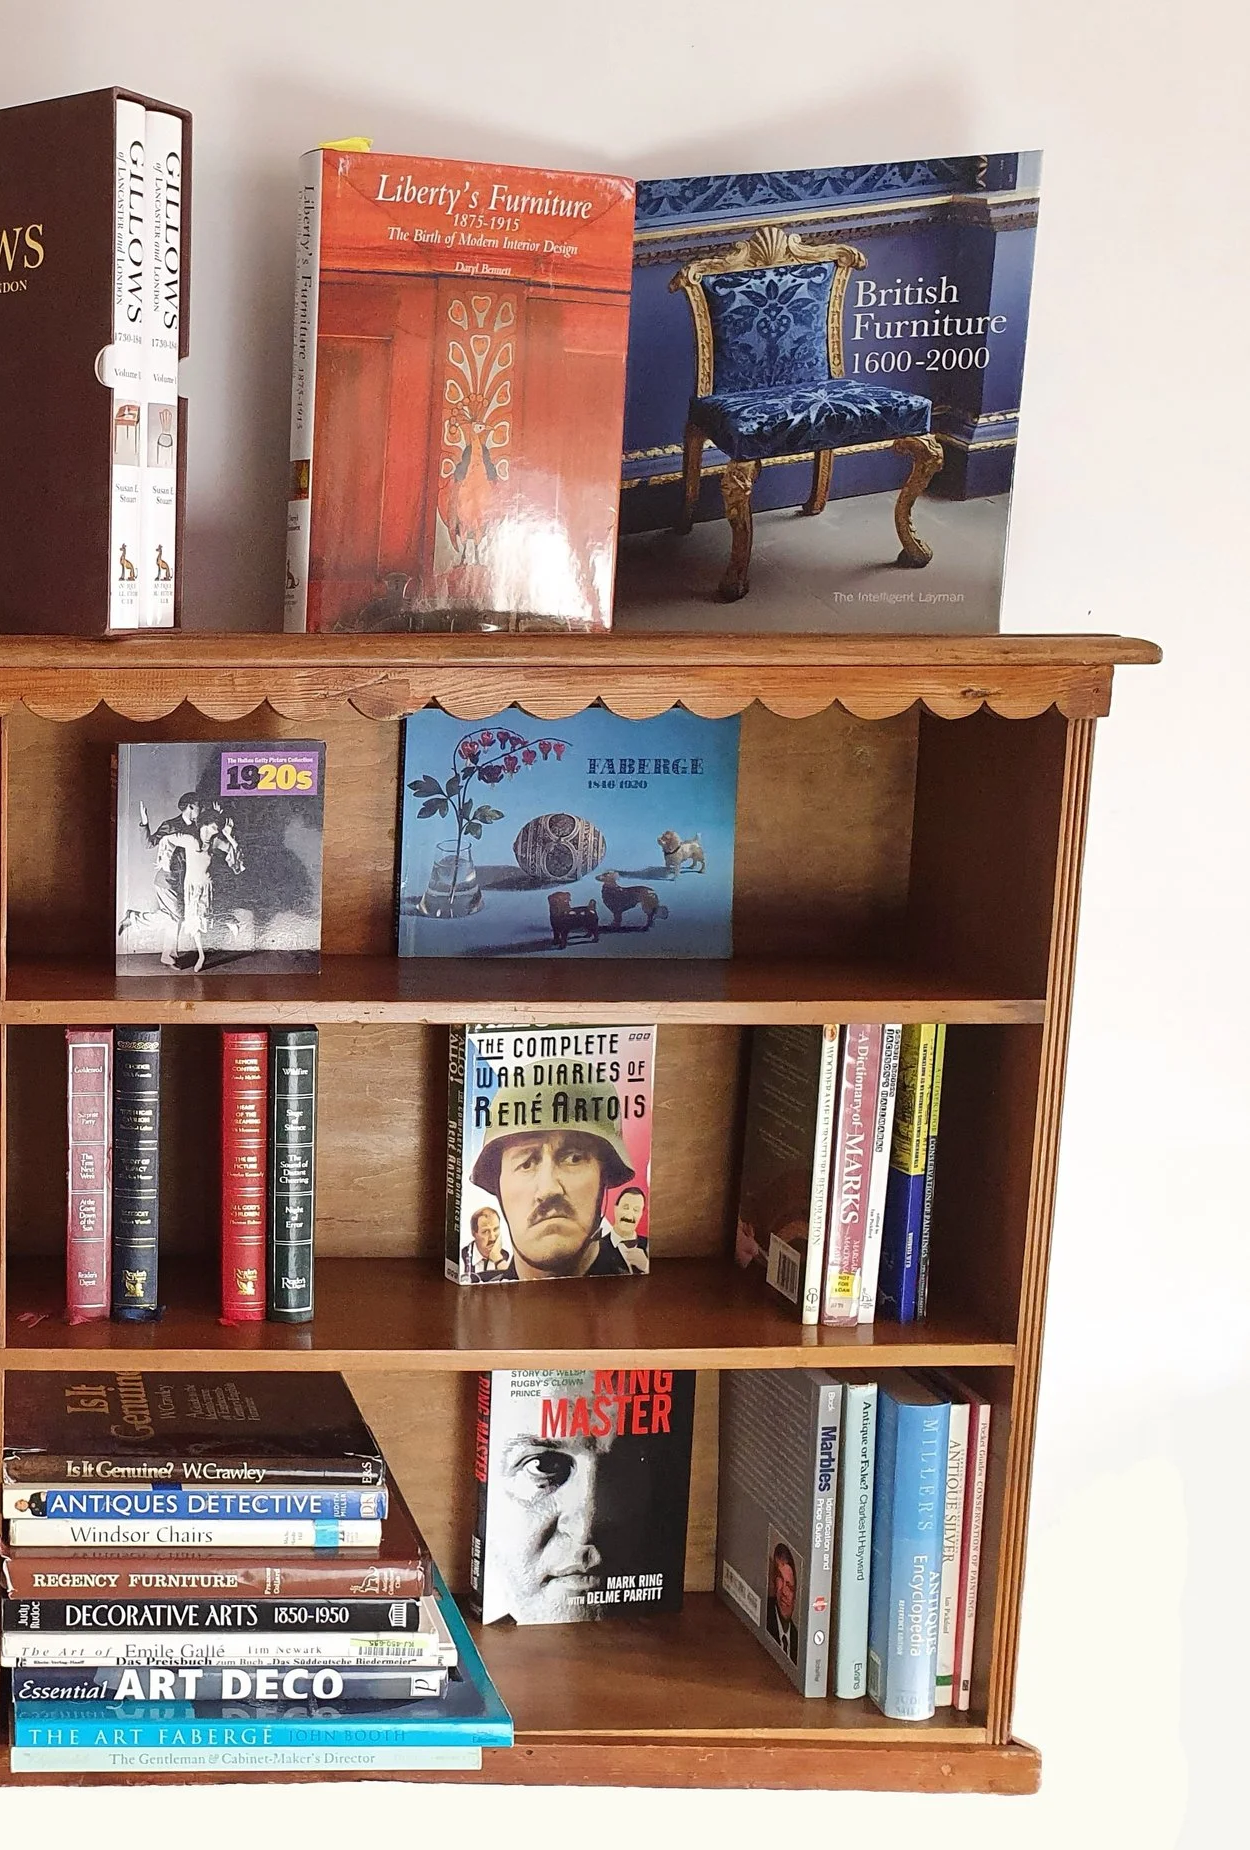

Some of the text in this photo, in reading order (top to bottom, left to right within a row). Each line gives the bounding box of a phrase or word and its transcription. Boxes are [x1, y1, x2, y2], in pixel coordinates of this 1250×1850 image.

[375, 173, 593, 220] Liberty's Furniture
[126, 140, 145, 323] GILLOWS
[452, 213, 520, 232] 1875-1915
[163, 151, 181, 330] GILLOWS
[387, 226, 578, 258] The Birth of Modern Interior Design
[454, 261, 512, 276] Daryl Bennett
[853, 275, 960, 309] British
[850, 308, 1008, 342] Furniture
[851, 346, 990, 374] 1600-2000
[833, 591, 965, 604] The Intelligent Layman
[226, 763, 313, 791] 1920s
[586, 757, 705, 775] FABERGE
[476, 1033, 620, 1059] THE COMPLETE
[475, 1060, 646, 1090] WAR DIARIES OF
[840, 1032, 869, 1225] A Dictionary of MARKS
[285, 1220, 304, 1229] Error
[510, 1370, 540, 1378] STORY
[542, 1369, 554, 1377] OF
[510, 1378, 584, 1388] RUGBY'S CLOWN
[593, 1369, 674, 1395] RING
[510, 1389, 541, 1398] PRINCE
[539, 1394, 673, 1441] MASTER
[859, 1400, 872, 1446] Antique
[978, 1422, 988, 1449] Pocket
[818, 1425, 838, 1493] Marbles
[860, 1446, 868, 1460] or
[65, 1461, 79, 1478] Is
[81, 1461, 94, 1478] It
[95, 1460, 174, 1480] Genuine?
[859, 1459, 871, 1491] Fake?
[917, 1419, 940, 1531] MILLER'S
[49, 1494, 322, 1514] ANTIQUES DETECTIVE
[340, 1491, 348, 1518] MILLER
[858, 1493, 869, 1530] Charles
[941, 1438, 963, 1564] ANTIQUE SILVER
[70, 1526, 213, 1544] Windsor Chairs
[814, 1497, 825, 1549] Price Guide
[822, 1497, 834, 1571] Identification and
[970, 1554, 979, 1567] OF
[32, 1573, 238, 1588] REGENCY FURNITURE
[264, 1567, 272, 1595] Frances
[273, 1567, 281, 1595] Collard
[606, 1572, 664, 1590] MARK RING
[567, 1586, 664, 1606] WITH DELME PARFITT
[908, 1555, 928, 1657] Encyclopedia
[18, 1603, 31, 1626] Judy
[65, 1604, 350, 1627] DECORATIVE ARTS 1850-1950
[925, 1571, 941, 1656] ANTIQUES
[21, 1643, 323, 1658] The Art of Emile Gallé Tim Newark
[116, 1656, 143, 1666] Das
[147, 1656, 213, 1666] Preisbuch
[18, 1668, 344, 1700] Essential ART DECO
[853, 1662, 863, 1690] Evans
[28, 1729, 80, 1745] THE
[94, 1729, 144, 1745] ART
[289, 1729, 339, 1743] JOHN
[343, 1729, 406, 1743] BOOTH
[109, 1753, 135, 1765] The
[138, 1753, 206, 1765] Gentleman
[208, 1753, 220, 1765] &
[221, 1752, 321, 1765] Cabinet-Maker's
[324, 1752, 376, 1764] Director
